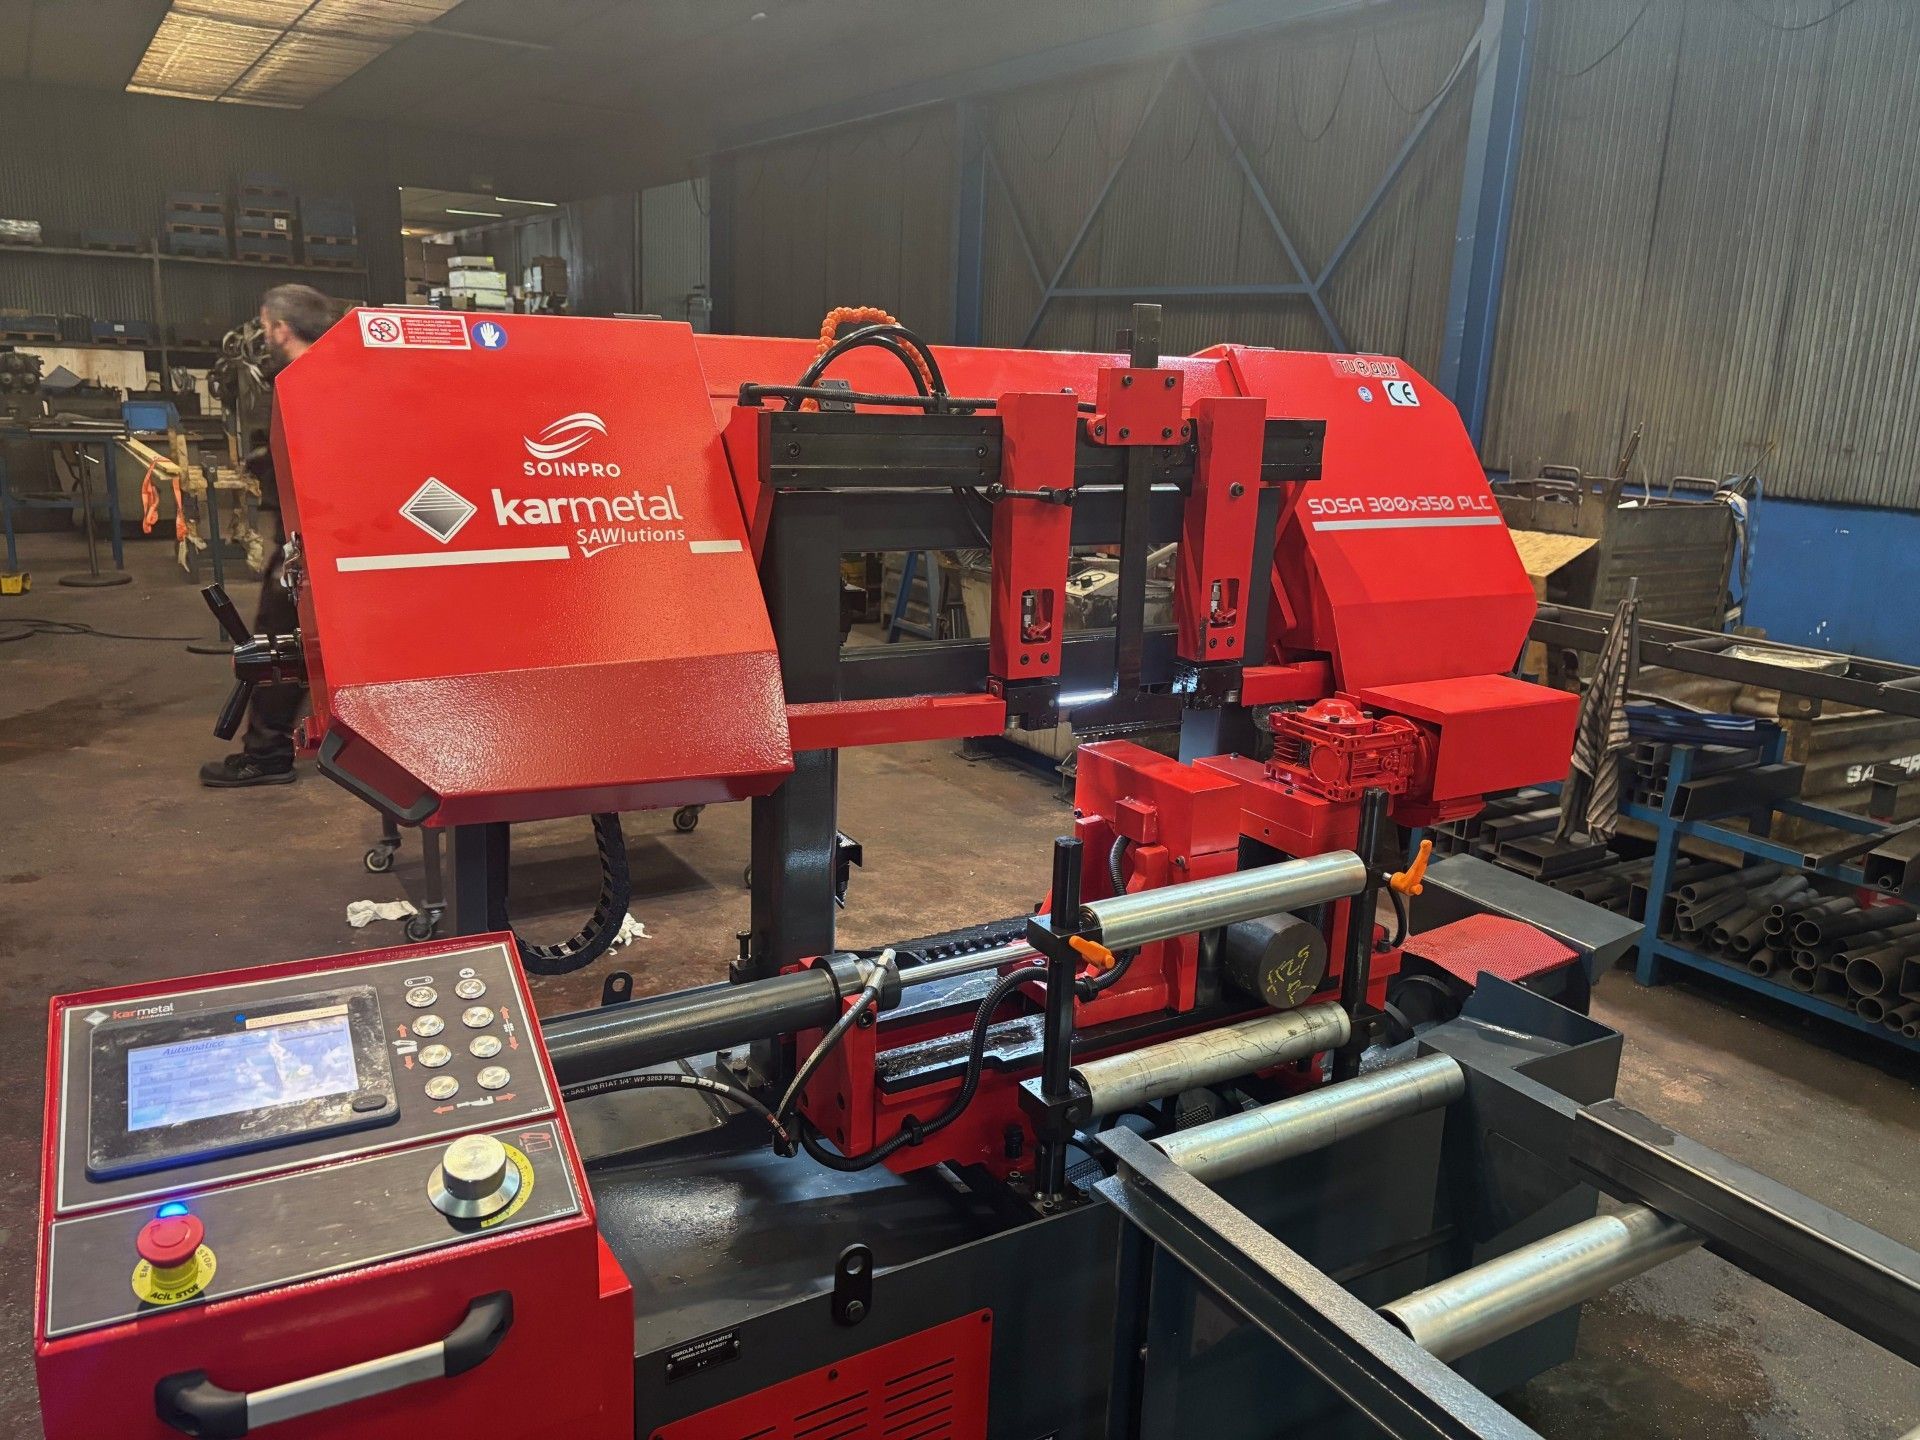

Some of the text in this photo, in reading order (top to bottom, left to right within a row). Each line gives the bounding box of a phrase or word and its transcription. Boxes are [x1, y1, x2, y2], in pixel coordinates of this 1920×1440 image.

[1387, 382, 1417, 405] CE
[523, 461, 621, 478] SOINPRO
[491, 485, 684, 526] karmetal
[1307, 495, 1493, 515] SOSA 300x350 PLC
[112, 1003, 174, 1020] karmetal
